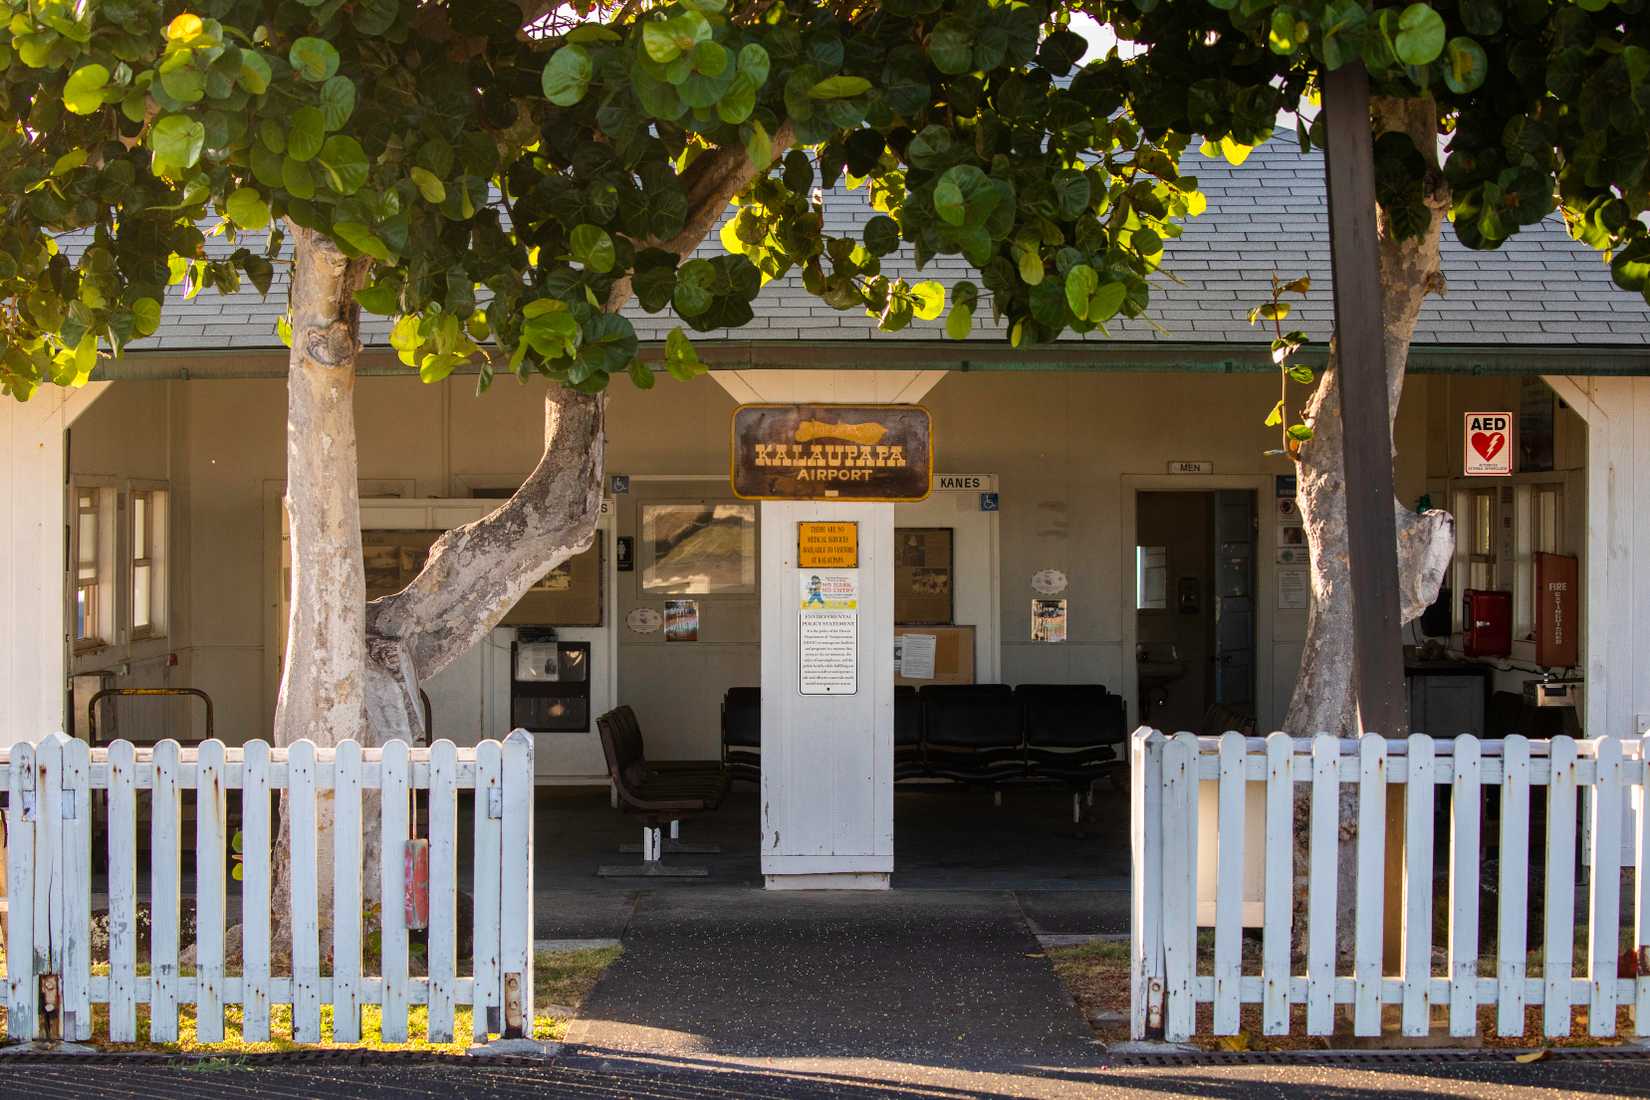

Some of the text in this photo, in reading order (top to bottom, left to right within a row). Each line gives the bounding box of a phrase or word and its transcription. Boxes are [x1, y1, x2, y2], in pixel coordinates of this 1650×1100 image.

[1471, 417, 1506, 430] AED
[754, 443, 907, 467] KALAUPAPA
[1180, 463, 1200, 472] MEN
[797, 469, 873, 481] AIRPORT
[940, 478, 980, 489] KANES
[1549, 583, 1568, 592] FIRE
